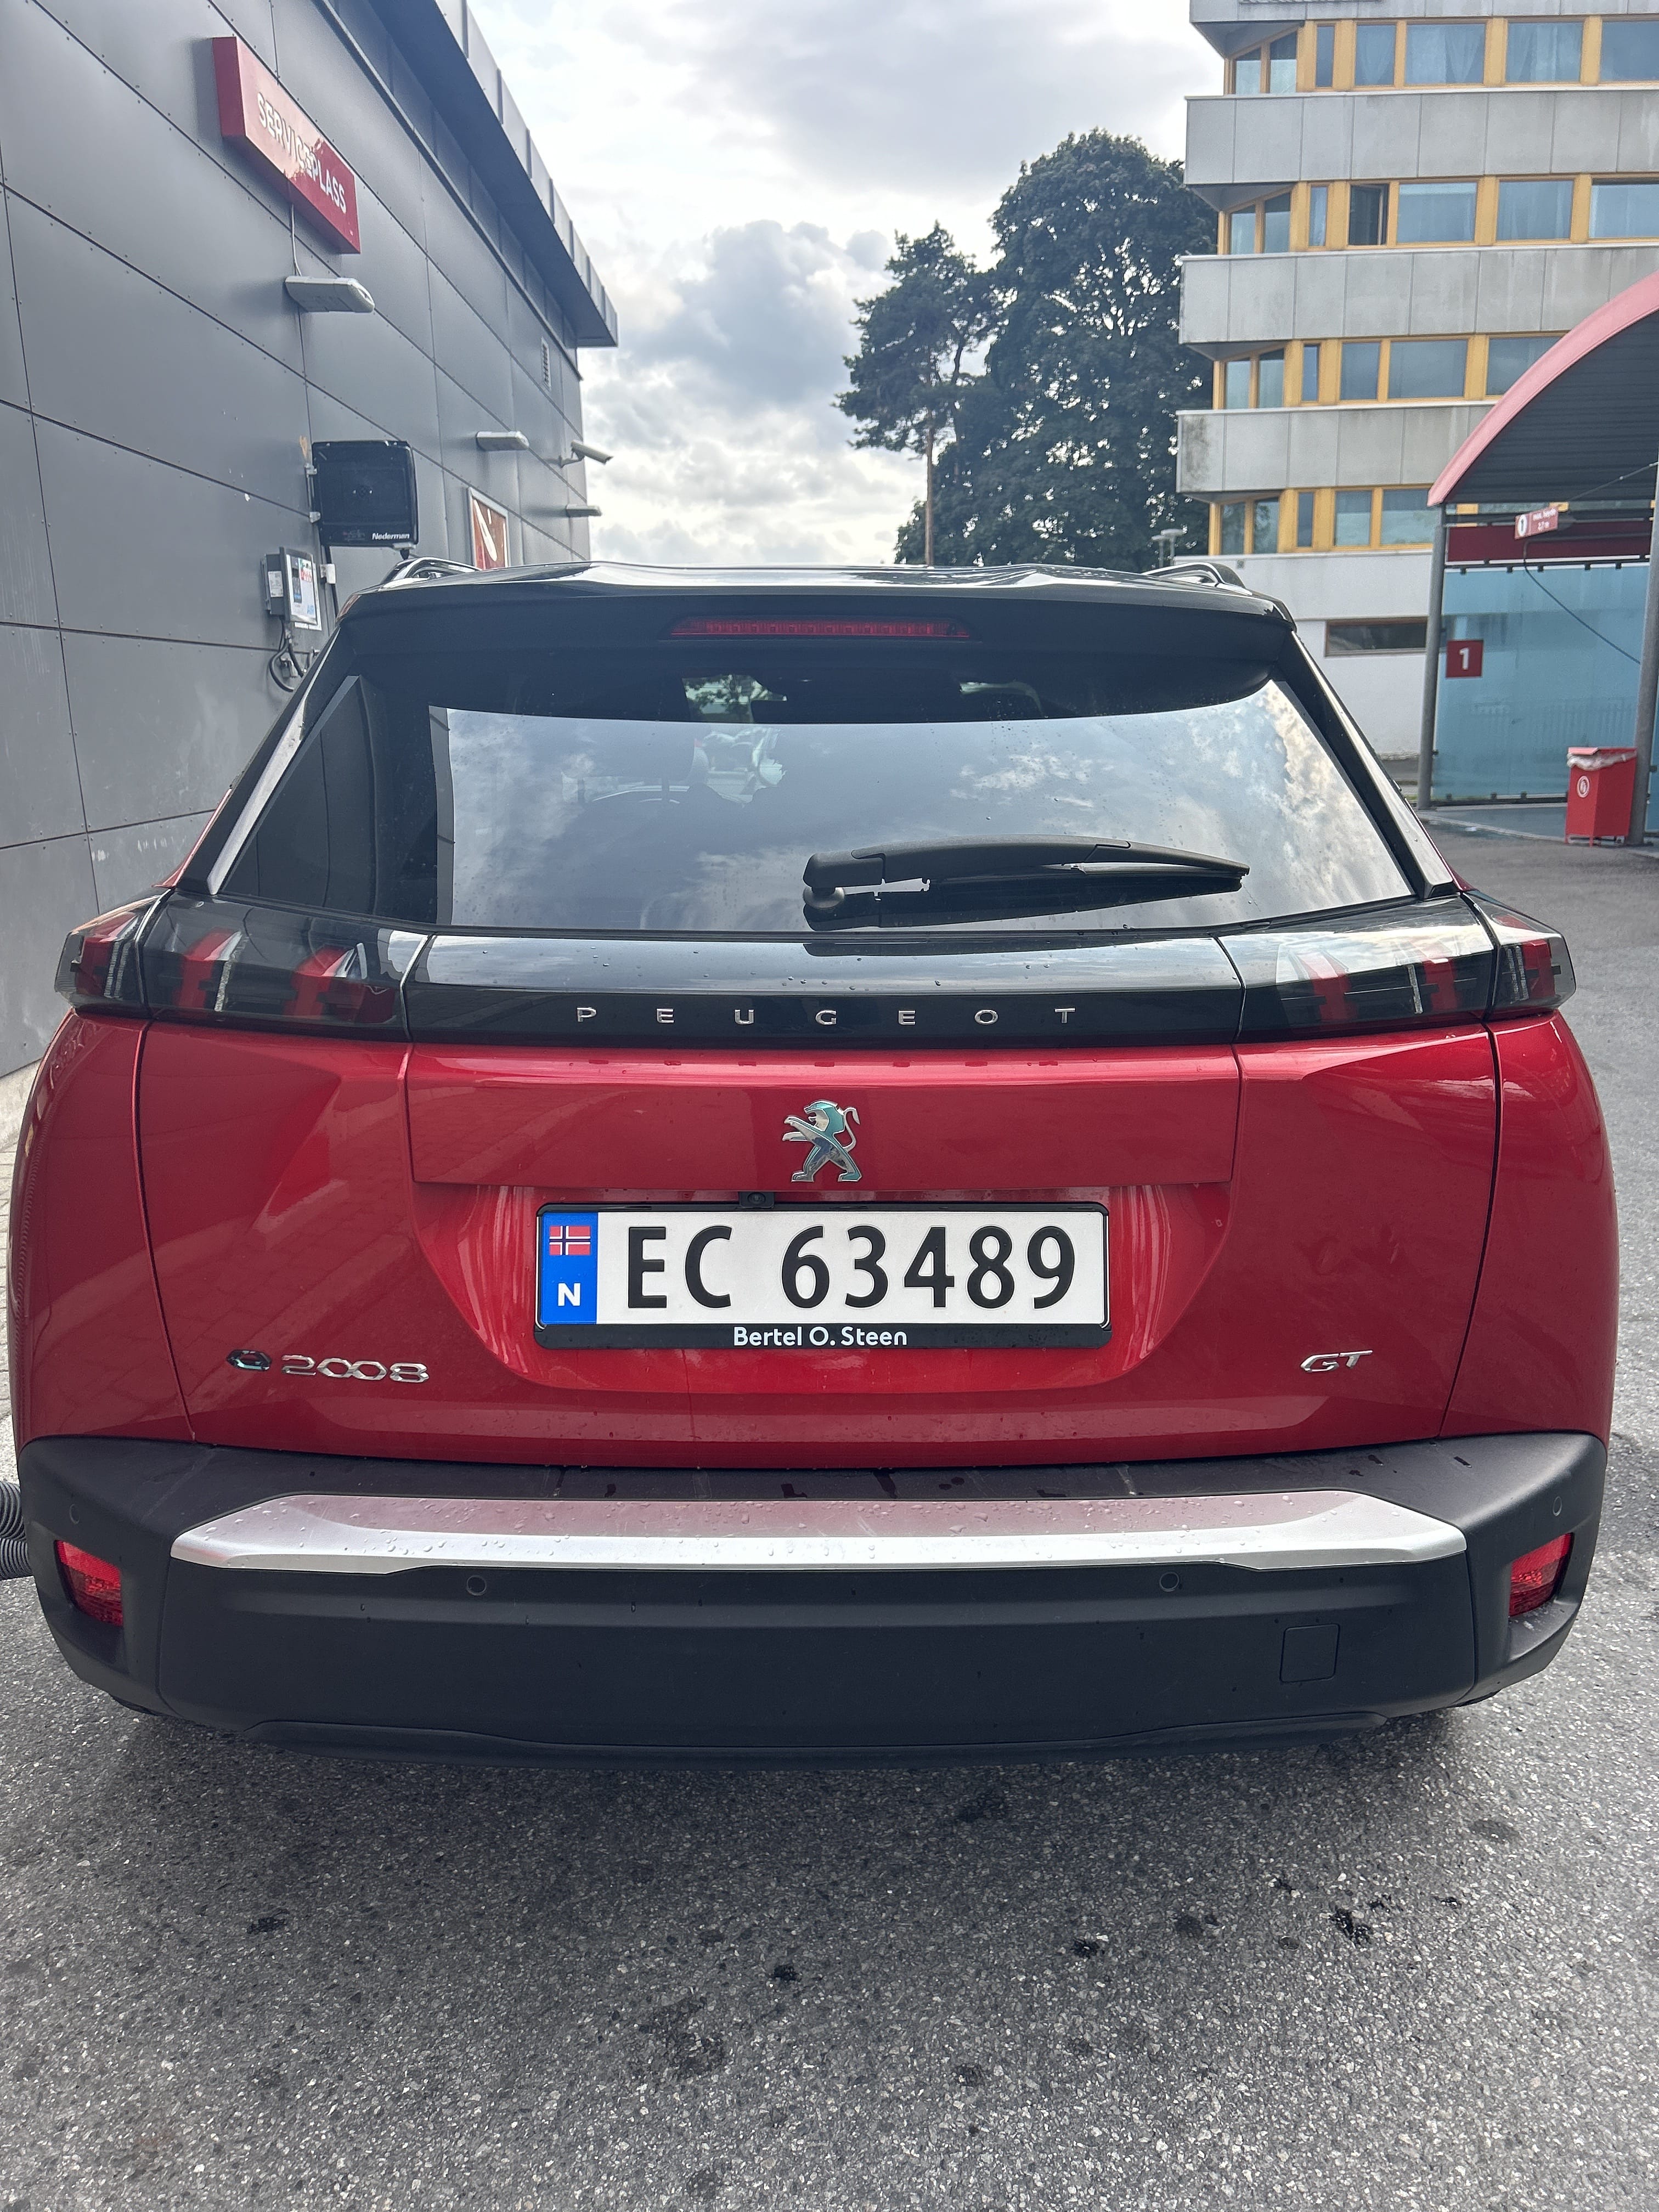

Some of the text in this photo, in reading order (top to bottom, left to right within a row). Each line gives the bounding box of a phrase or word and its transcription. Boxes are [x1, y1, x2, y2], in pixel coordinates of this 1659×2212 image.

[372, 532, 410, 540] Nederman
[1459, 647, 1469, 670] 1
[577, 1007, 1076, 1025] PEUGEOT
[627, 1224, 1076, 1310] EC 63489
[557, 1282, 582, 1307] N
[733, 1325, 907, 1346] Bertel O. Steen
[281, 1354, 430, 1384] 2008
[1300, 1350, 1373, 1373] GT
